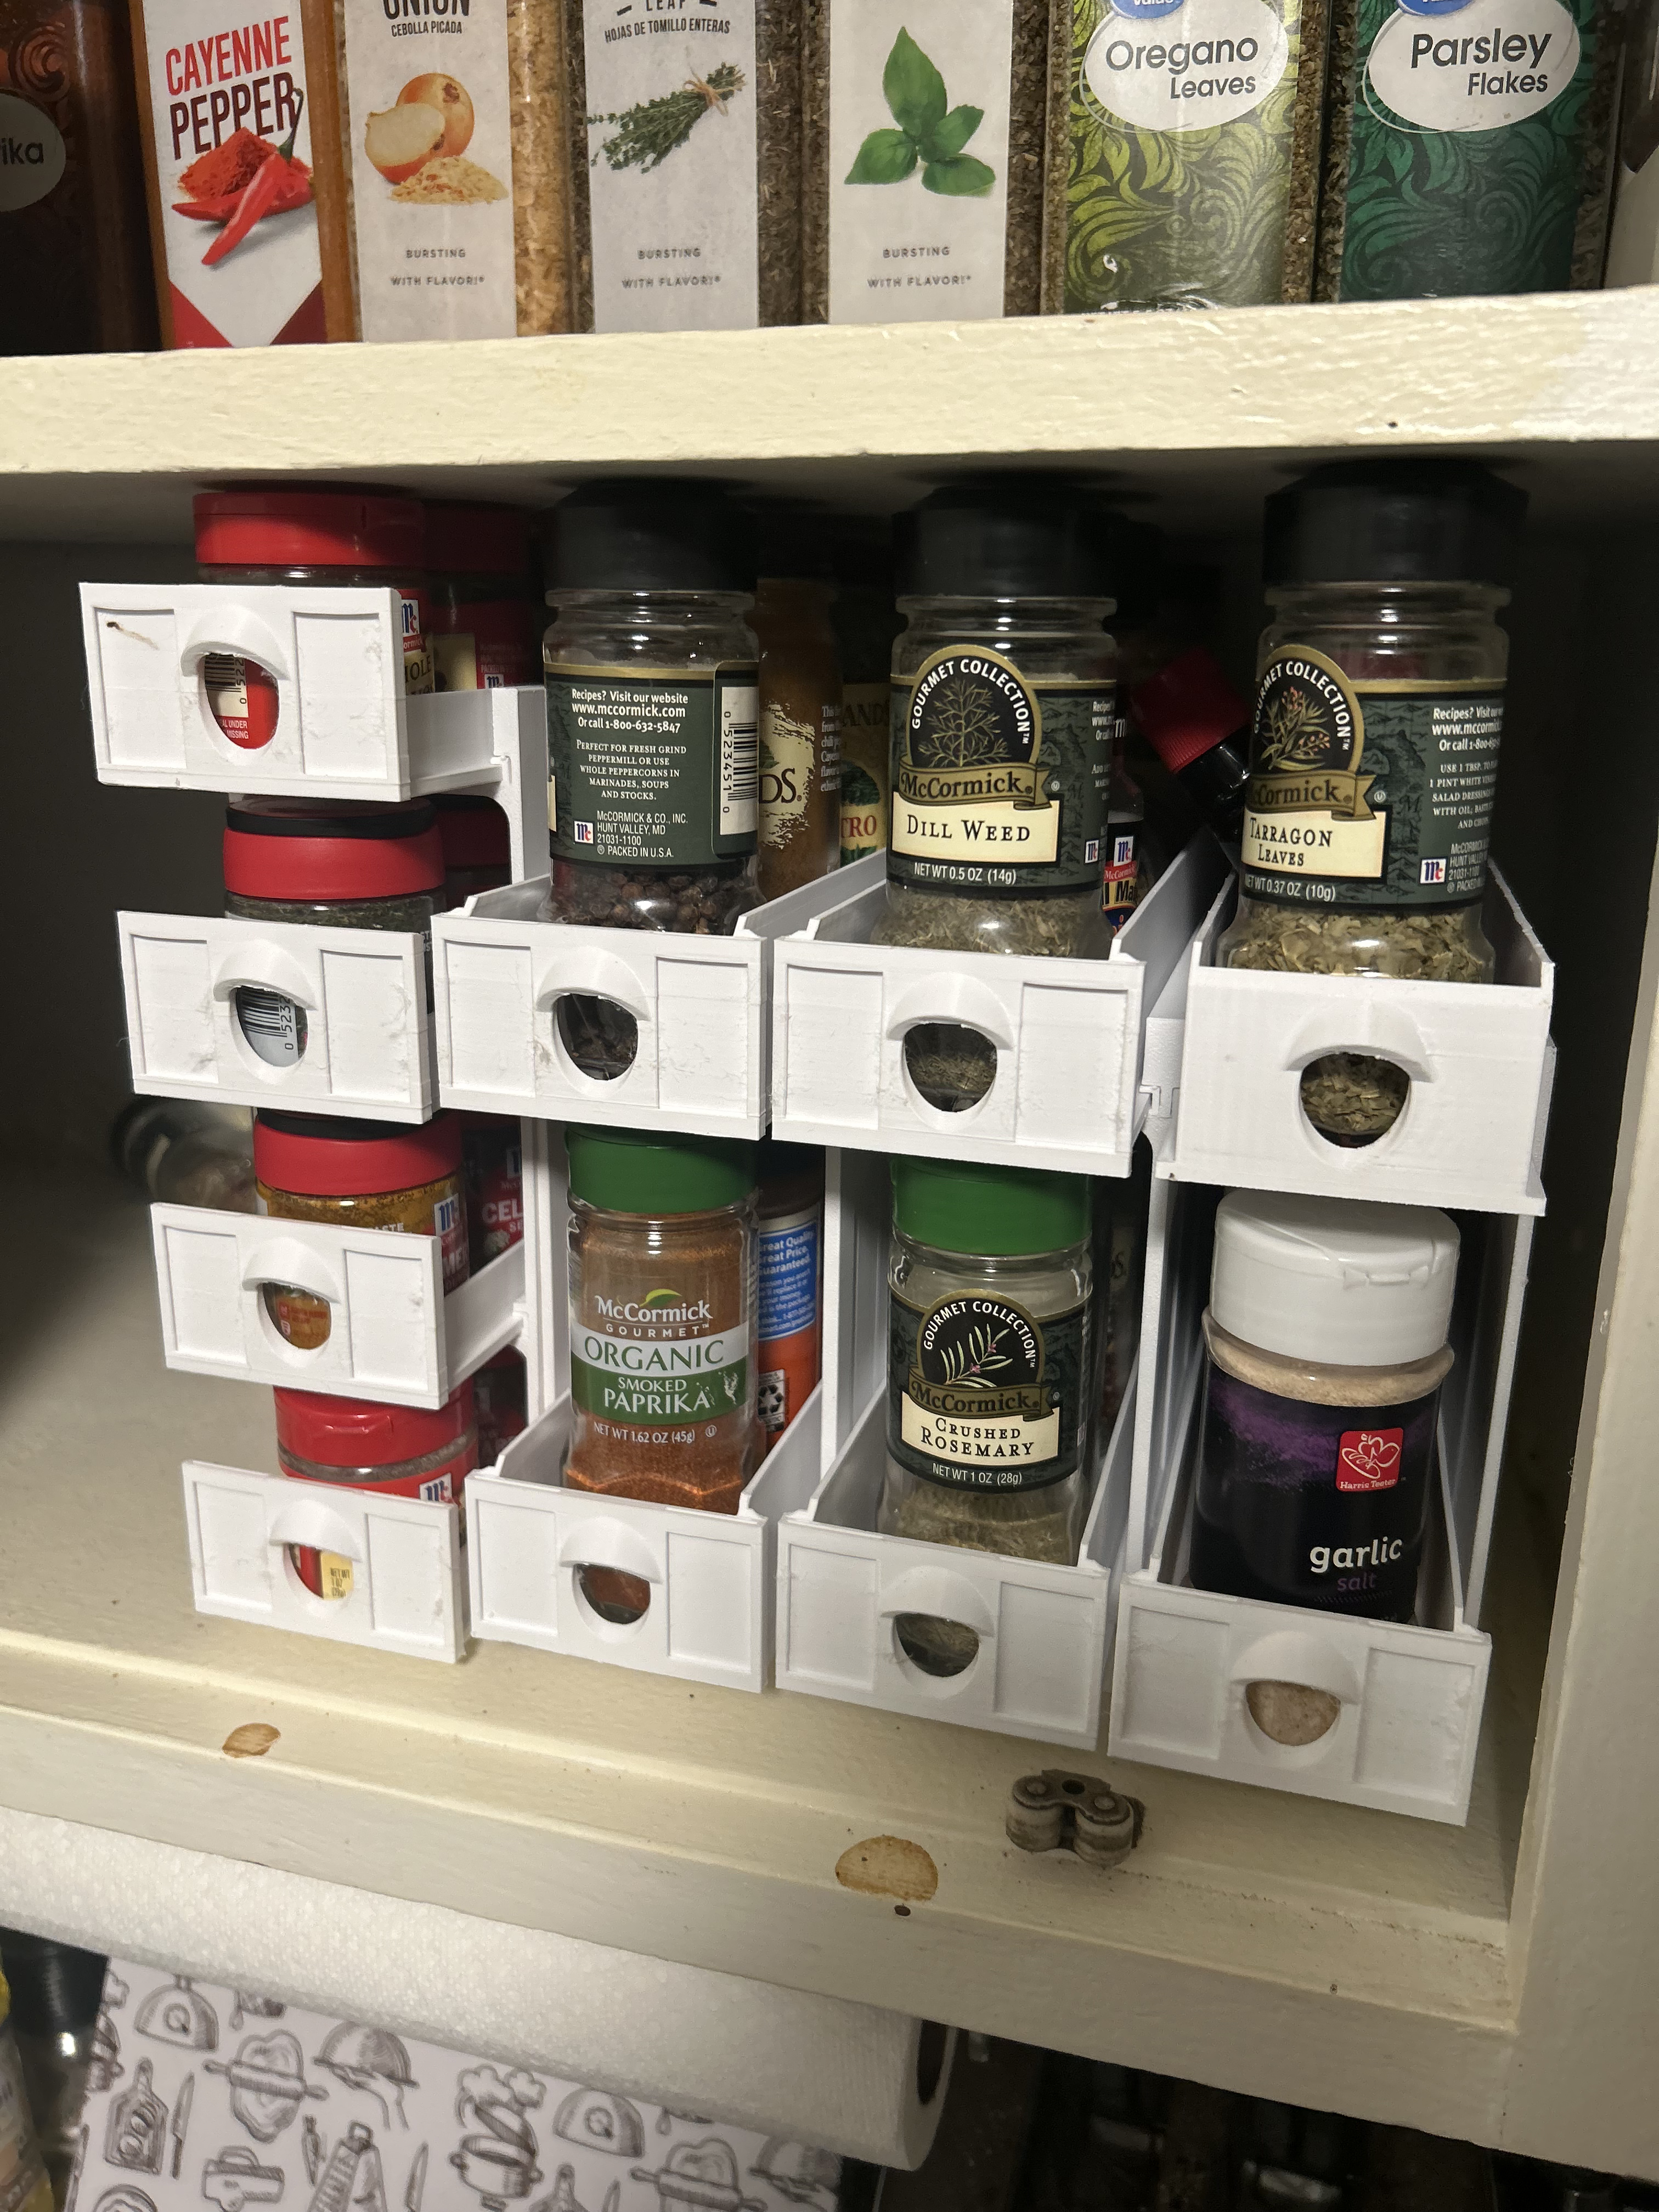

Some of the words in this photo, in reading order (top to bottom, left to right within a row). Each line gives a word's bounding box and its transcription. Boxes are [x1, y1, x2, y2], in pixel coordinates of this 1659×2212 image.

[391, 21, 428, 37] CEBOLLA
[431, 21, 462, 34] PICADA
[605, 25, 631, 43] HOJAS
[634, 21, 646, 36] DE
[647, 18, 686, 33] TOMILLO
[689, 18, 730, 34] ENTERAS
[165, 16, 292, 96] CAYENNE
[1106, 37, 1259, 75] Oregano
[1411, 28, 1553, 69] Parsley
[1171, 76, 1256, 99] Leaves
[1468, 71, 1548, 96] Flakes
[170, 71, 296, 160] PEPPER
[406, 249, 466, 258] BURSTING
[637, 248, 701, 259] BURSTING
[883, 247, 950, 258] BURSTING
[390, 276, 421, 286] WITH
[622, 277, 653, 289] WITH
[867, 278, 902, 288] WITH
[572, 689, 607, 702] Recipes?
[610, 691, 631, 702] Visit
[633, 693, 650, 703] our
[651, 692, 689, 703] website
[911, 661, 955, 730] GOURMET
[572, 703, 686, 717] www.mccormick.com
[1433, 707, 1474, 722] Recipes?
[1476, 706, 1490, 718] Visit
[229, 720, 247, 729] UNDER
[578, 716, 587, 727] Or
[589, 718, 603, 729] call
[605, 719, 681, 733] 1-800-632-5847
[576, 739, 609, 752] PERFECT
[611, 744, 627, 753] FOR
[629, 745, 656, 753] FRESH
[658, 746, 686, 754] GRIND
[1439, 739, 1451, 752] Or
[1452, 738, 1468, 751] call
[588, 754, 637, 765] PEPPERMILL
[639, 757, 651, 765] OR
[653, 758, 670, 766] USE
[580, 765, 607, 775] WHOLE
[609, 767, 668, 777] PEPPERCORNS
[1440, 764, 1457, 774] USE
[1459, 763, 1463, 772] 1
[642, 780, 669, 789] SOUPS
[1430, 779, 1434, 788] 1
[1437, 778, 1459, 788] PINT
[1460, 776, 1481, 786] WHITE
[601, 790, 619, 798] AND
[620, 791, 657, 800] STOCKS.
[1432, 792, 1460, 803] SALAD
[597, 810, 645, 823] McCORMICK
[646, 813, 652, 823] &
[673, 813, 688, 823] INC.
[1433, 806, 1457, 816] WITH
[597, 822, 618, 833] HUNT
[619, 823, 651, 836] VALLEY,
[652, 825, 666, 835] MD
[907, 814, 952, 839] DILL
[961, 820, 1030, 841] WEED
[1250, 817, 1333, 847] TARRAGON
[1458, 820, 1473, 830] AND
[597, 834, 641, 846] 21031-1100
[608, 845, 638, 857] PACKED
[640, 848, 648, 857] IN
[651, 848, 674, 857] U.S.A.
[1258, 844, 1304, 866] LEAVES
[1450, 855, 1467, 867] HUNT
[914, 862, 932, 877] NET
[932, 865, 946, 878] WT
[949, 866, 965, 881] 0.5
[967, 867, 982, 881] OZ
[988, 868, 1017, 885] (14g)
[1255, 877, 1266, 891] WT
[1267, 879, 1285, 894] 0.37
[1287, 882, 1300, 896] OZ
[1306, 884, 1336, 902] (10g)
[760, 1240, 784, 1251] reat
[760, 1251, 784, 1263] reat
[595, 1295, 713, 1323] McCormick
[923, 1301, 967, 1350] GOURMET
[584, 1336, 724, 1371] ORGANIC
[618, 1377, 687, 1392] SMOKED
[604, 1387, 710, 1414] PAPRIKA
[594, 1421, 610, 1436] NET
[612, 1427, 628, 1440] WT
[631, 1430, 649, 1443] 1.62
[652, 1432, 668, 1443] OZ
[672, 1429, 695, 1444] (45g)
[936, 1417, 1020, 1439] CRUSHED
[921, 1426, 1035, 1457] ROSEMARY
[933, 1463, 950, 1477] NET
[952, 1469, 966, 1481] WT
[970, 1471, 974, 1482] 1
[978, 1471, 992, 1483] OZ
[997, 1471, 1022, 1486] (28g)
[1340, 1481, 1369, 1489] Harris
[1371, 1479, 1396, 1488] Teeter
[1310, 1537, 1403, 1573] garlic
[1338, 1572, 1376, 1592] salt
